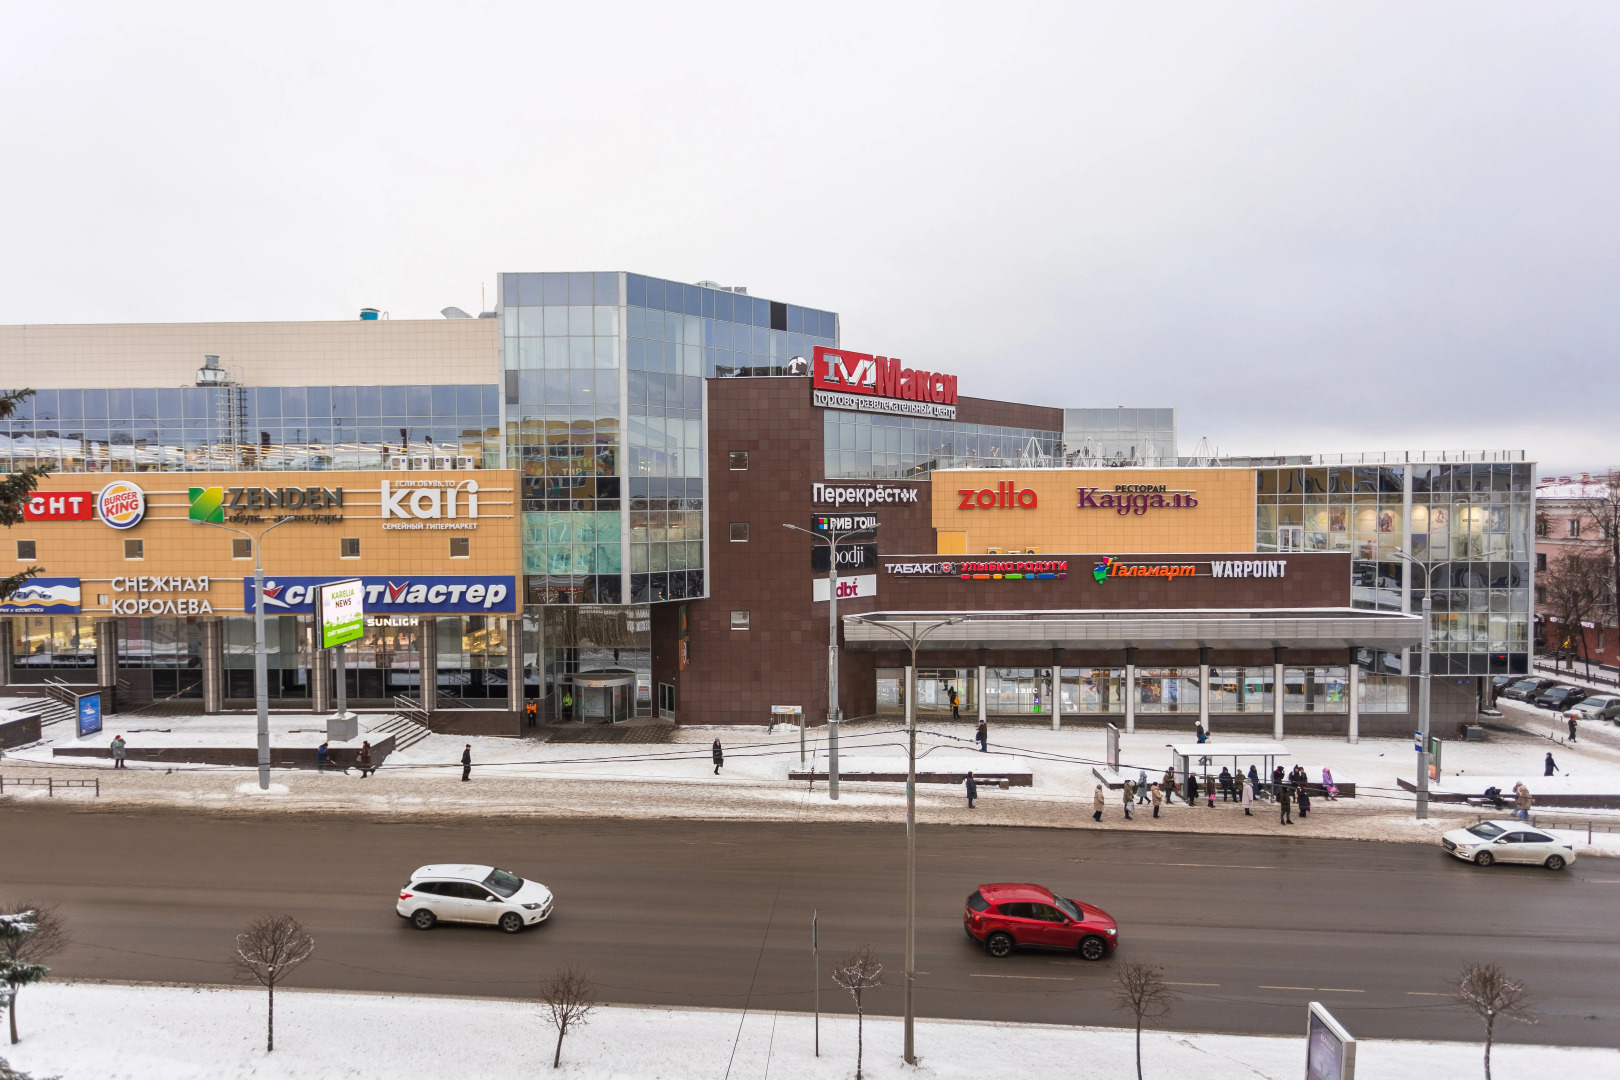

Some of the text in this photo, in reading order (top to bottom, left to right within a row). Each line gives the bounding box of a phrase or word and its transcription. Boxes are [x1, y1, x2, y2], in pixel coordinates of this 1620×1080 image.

[875, 355, 958, 405] Макси
[933, 405, 957, 418] центр
[957, 480, 1038, 509] zolla
[1114, 484, 1166, 493] РЕСТОРАН
[17, 496, 83, 514] GHT
[104, 491, 138, 506] BURGER
[228, 486, 343, 510] ZENDEN
[381, 480, 478, 519] kari
[105, 499, 139, 518] KING
[229, 512, 265, 525] обувь
[382, 522, 424, 530] СЕМЕЙНЫЙ
[830, 518, 852, 530] РИВ
[885, 563, 932, 574] ТАБАК
[1111, 562, 1196, 581] Галамарт
[1211, 560, 1286, 578] WARPOINT
[112, 576, 209, 592] СНЕЖНАЯ
[332, 588, 354, 600] KARELIA
[112, 599, 213, 614] КОРОЛЕВА
[336, 598, 352, 608] NEWS
[366, 618, 418, 626] SUNLIGH
